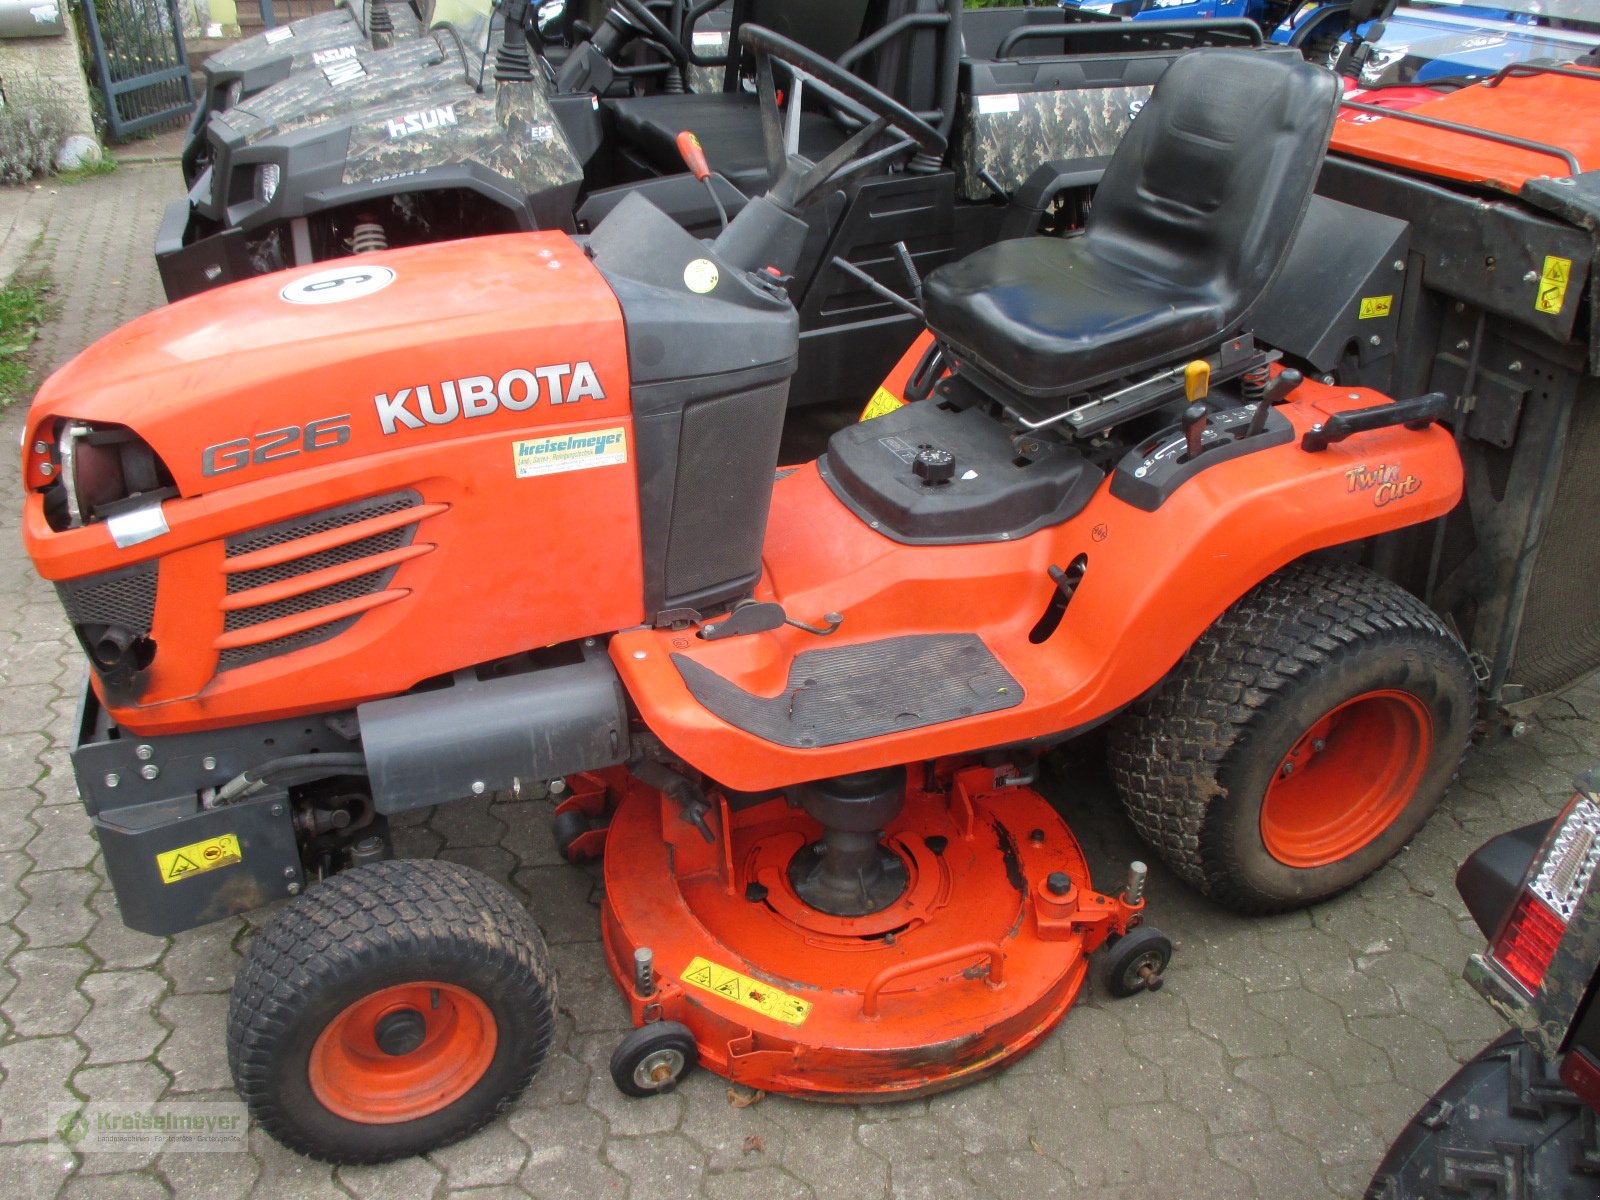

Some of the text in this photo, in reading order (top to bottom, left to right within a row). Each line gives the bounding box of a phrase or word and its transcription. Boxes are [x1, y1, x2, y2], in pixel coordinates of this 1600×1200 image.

[531, 125, 553, 138] EPS
[373, 361, 607, 435] KUBOTA
[201, 413, 352, 478] G26
[518, 433, 623, 457] kreiselmeyer
[1343, 463, 1400, 493] Twin
[1374, 475, 1422, 508] Cut
